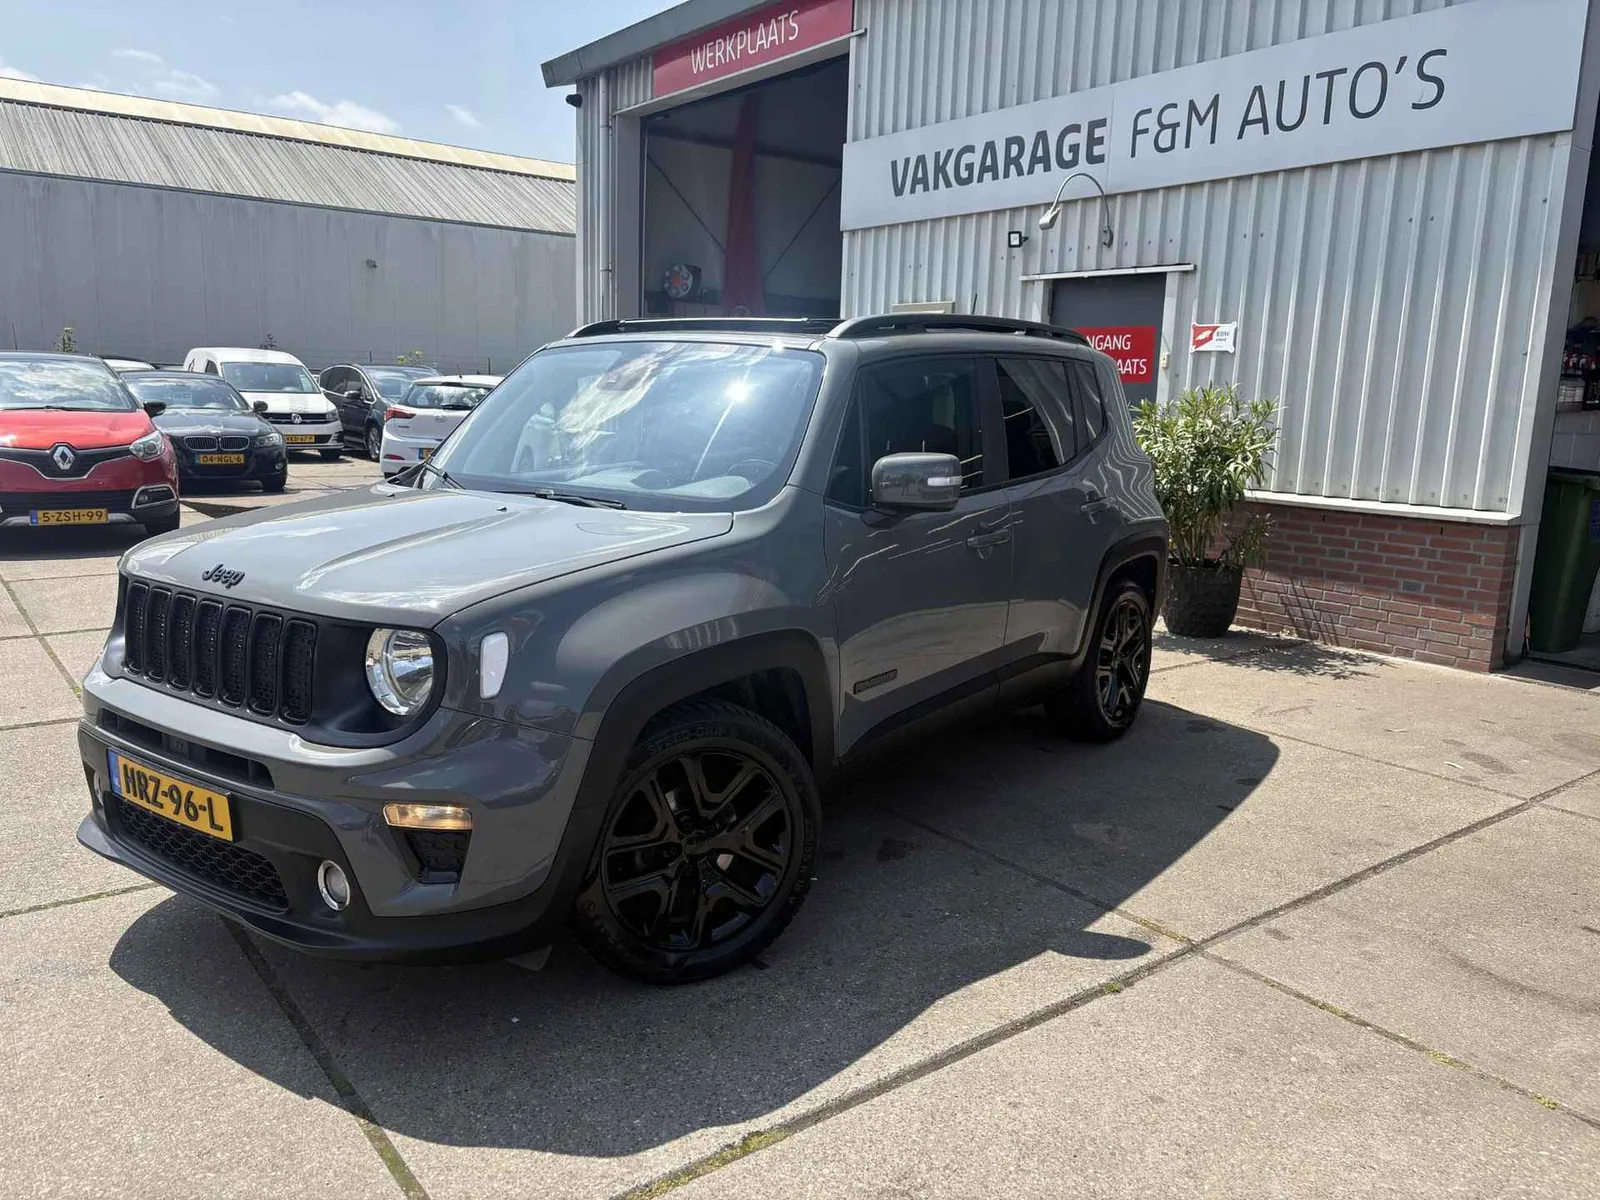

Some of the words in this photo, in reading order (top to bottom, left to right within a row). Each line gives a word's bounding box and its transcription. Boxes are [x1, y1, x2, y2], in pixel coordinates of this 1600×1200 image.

[690, 10, 800, 75] WERKPLAATS
[890, 117, 1108, 198] VAKGARAGE
[1130, 93, 1221, 159] F&M
[1236, 48, 1448, 141] AUTO'S
[1086, 334, 1132, 351] NGANG
[1117, 358, 1147, 375] AATS
[202, 455, 242, 463] 04-NGL-6
[42, 510, 104, 523] 5-ZSH-99
[202, 564, 246, 589] Jeep
[122, 764, 223, 832] HRZ-96-L
